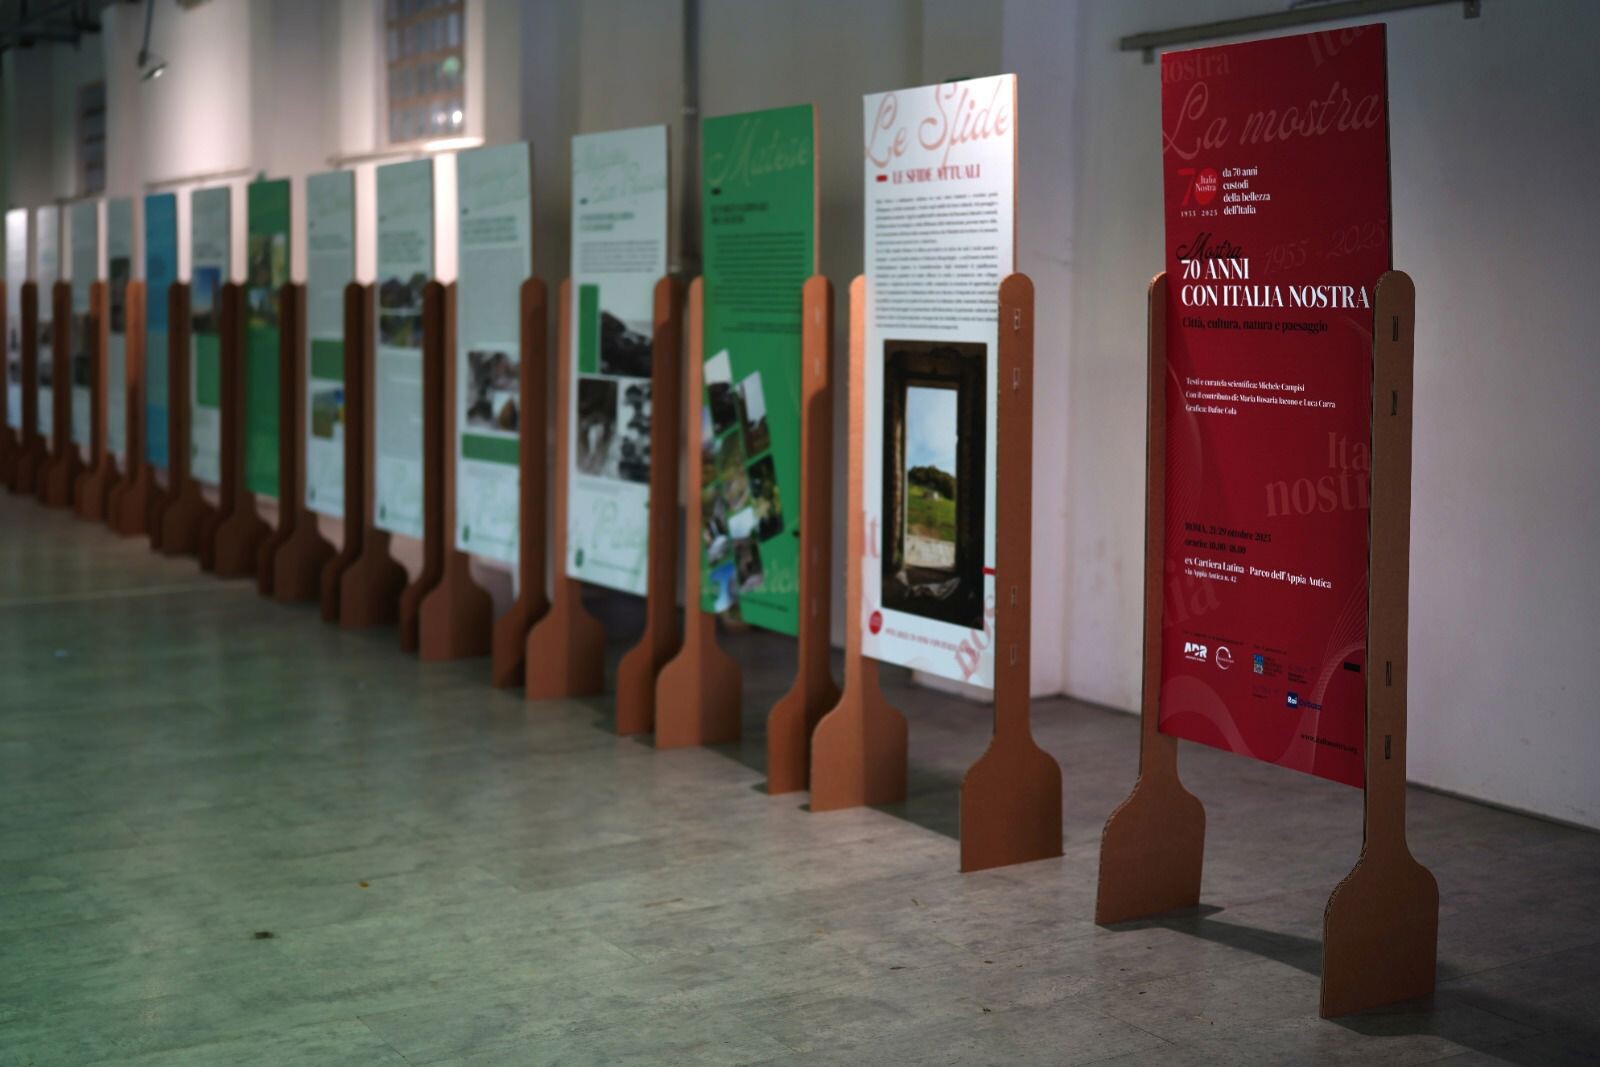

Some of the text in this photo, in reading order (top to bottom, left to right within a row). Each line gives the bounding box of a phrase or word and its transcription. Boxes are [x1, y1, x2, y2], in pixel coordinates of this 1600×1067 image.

[864, 91, 908, 168] Le
[1163, 81, 1382, 160] La mostra
[892, 163, 981, 184] LE SFIDE ATTUALI
[1200, 175, 1217, 184] Italia
[1222, 166, 1258, 177] da 70 anni
[1195, 183, 1217, 192] Nostra
[1222, 179, 1249, 190] custodi
[1223, 191, 1271, 202] della bellezza
[1223, 205, 1256, 215] dell'Italia
[1176, 232, 1243, 262] Mostra
[1181, 257, 1249, 280] 70 ANNI
[1181, 284, 1370, 308] CON ITALIA NOSTRA
[1207, 317, 1241, 330] cultura,
[1243, 319, 1273, 331] natura
[1275, 321, 1281, 331] e
[1282, 319, 1328, 336] paesaggio
[1186, 377, 1200, 386] Testi
[1204, 378, 1227, 388] curatela
[1258, 381, 1280, 391] Michele
[1281, 382, 1305, 393] Campisi
[1186, 390, 1197, 399] Con
[1202, 391, 1231, 401] contributo
[1239, 393, 1256, 403] Maria
[1256, 395, 1278, 405] Rosaria
[1304, 398, 1318, 408] Luca
[1185, 557, 1194, 565] ex
[1194, 556, 1222, 570] Cartiera
[1223, 560, 1245, 574] Latina
[1249, 566, 1270, 578] Parco
[1309, 577, 1332, 589] Antica
[1184, 641, 1208, 659] ADR
[1287, 696, 1298, 705] Rai
